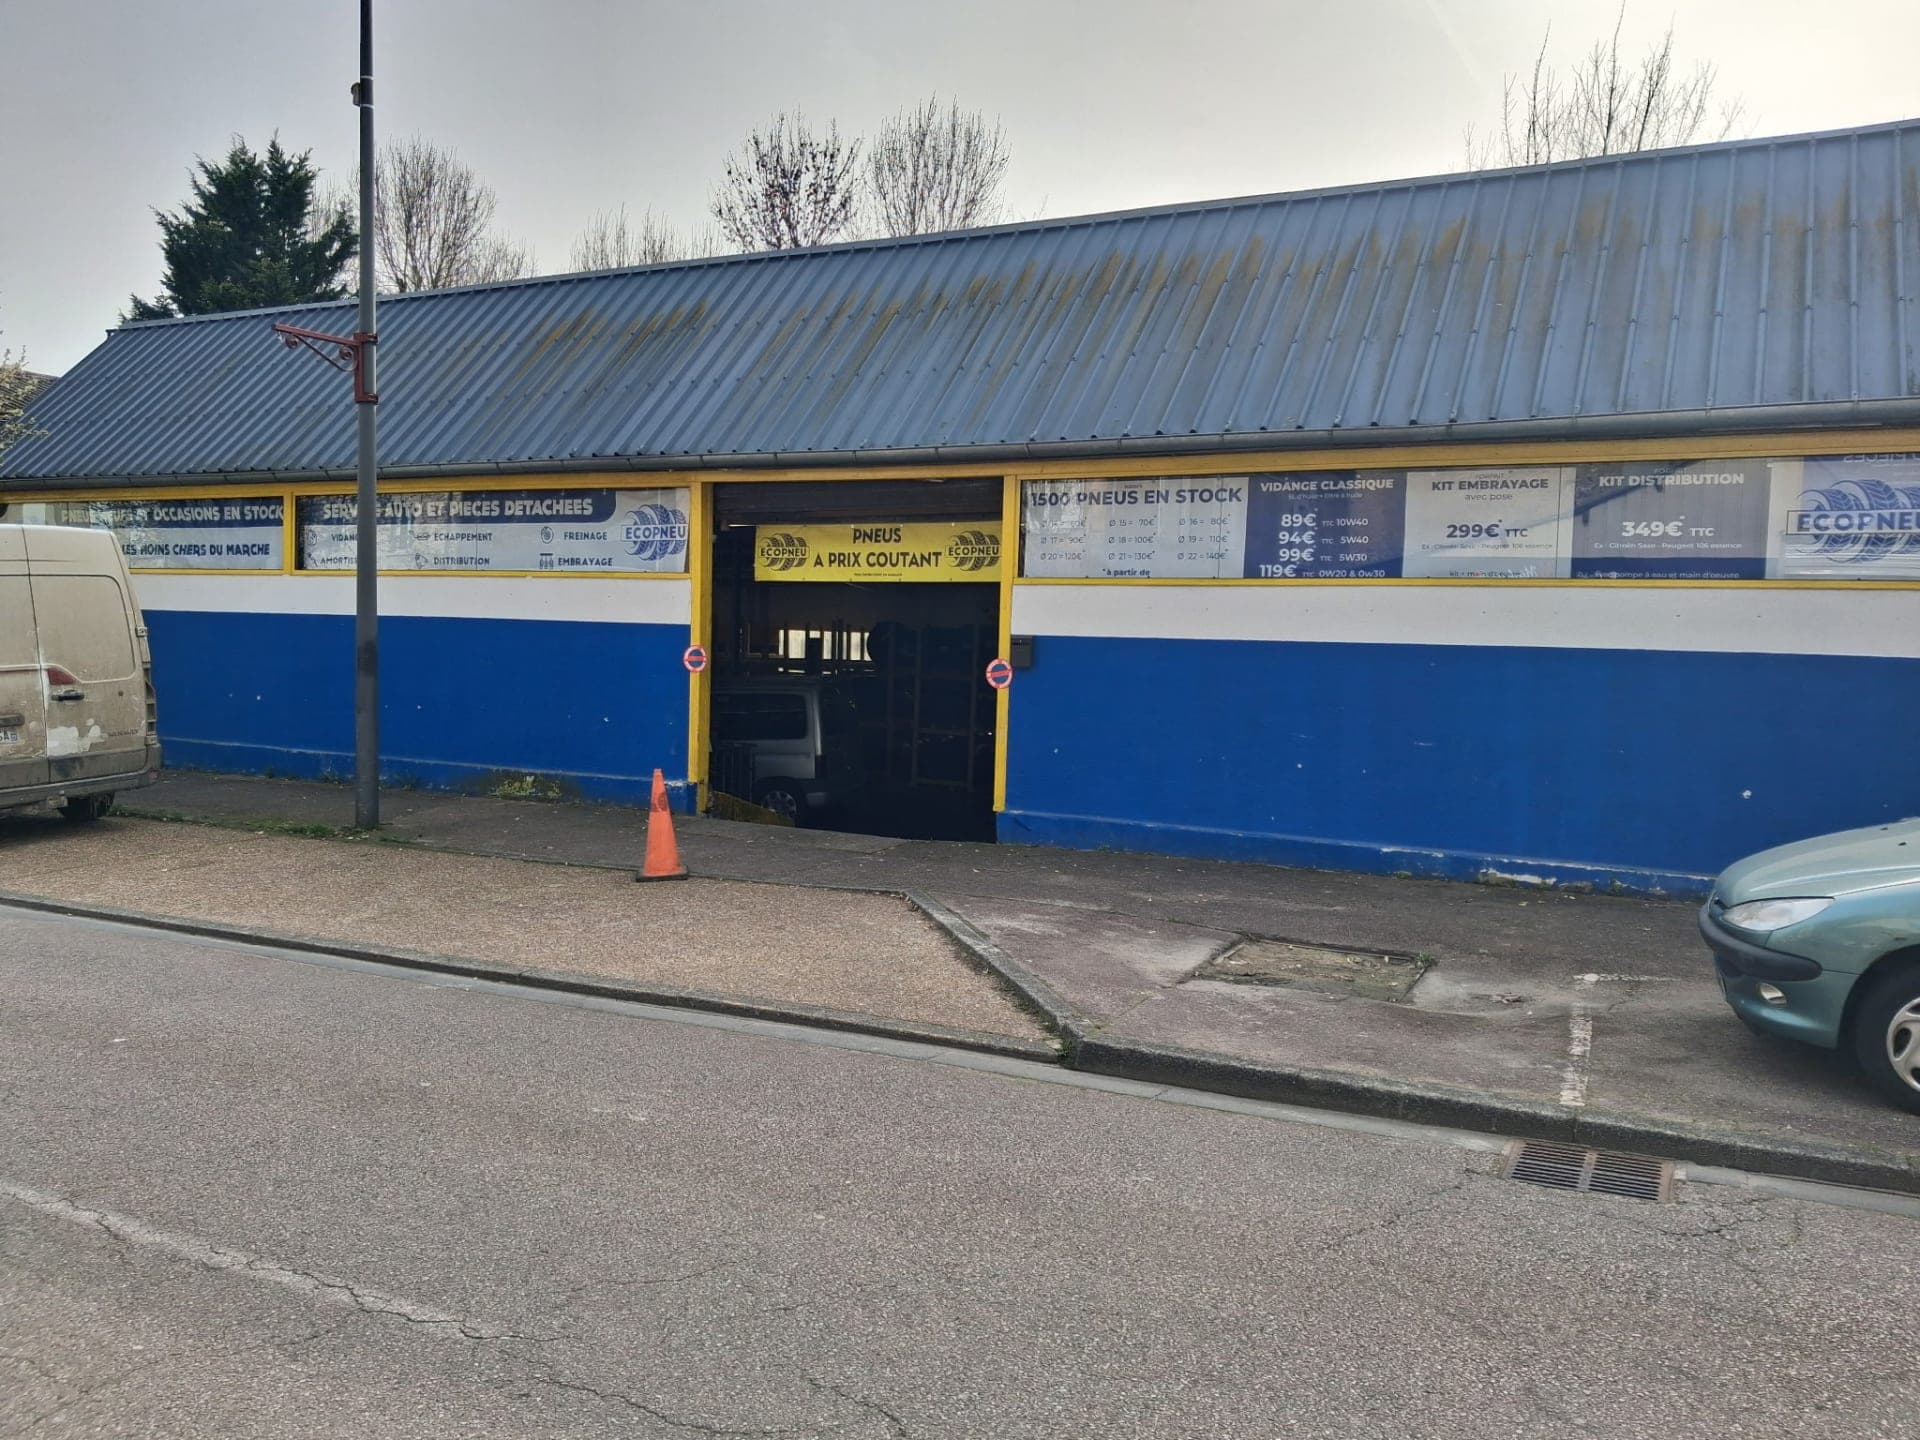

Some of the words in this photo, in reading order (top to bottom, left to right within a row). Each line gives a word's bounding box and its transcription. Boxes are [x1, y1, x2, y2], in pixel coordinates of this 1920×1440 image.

[1431, 481, 1455, 491] KIT
[1458, 478, 1550, 491] EMBRAYAGE
[1599, 476, 1625, 487] KIT
[1628, 473, 1745, 487] DISTRIBUTION
[1260, 481, 1318, 492] VIDANGE
[1320, 479, 1394, 491] CLASSIQUE
[1030, 492, 1070, 507] 1500
[1077, 490, 1139, 506] PNEUS
[1144, 489, 1169, 504] EN
[1175, 487, 1243, 503] STOCK
[153, 506, 222, 522] OCCASIONS
[224, 506, 241, 521] EN
[244, 505, 284, 520] STOCK
[323, 503, 380, 520] SERV
[385, 501, 423, 518] AUTO
[426, 501, 445, 516] ET
[449, 500, 500, 517] PIECES
[504, 499, 594, 516] DETACHEES
[1336, 518, 1369, 527] 10W40
[434, 532, 493, 542] ECHAPPEMENT
[563, 531, 608, 541] FREINAGE
[626, 525, 687, 540] ECOPNEU
[853, 527, 902, 545] PNEUS
[1505, 528, 1529, 538] TTC
[1689, 527, 1715, 537] TTC
[331, 533, 357, 542] VIDAN
[1340, 536, 1369, 544] 5W40
[122, 544, 137, 556] LES
[140, 543, 170, 556] MOINS
[173, 543, 207, 556] CHERS
[209, 543, 223, 555] DU
[226, 543, 271, 556] MARCHE
[760, 547, 807, 557] ECOPNEU
[948, 546, 1000, 556] ECOPNEU
[434, 557, 490, 565] DISTRIBUTION
[558, 557, 613, 566] EMBRAYAGE
[813, 552, 824, 568] A
[828, 551, 862, 568] PRIX
[866, 551, 943, 568] COUTANT
[1339, 554, 1368, 562] 5W30
[1113, 568, 1139, 578] partir
[1318, 569, 1347, 578] 0W20
